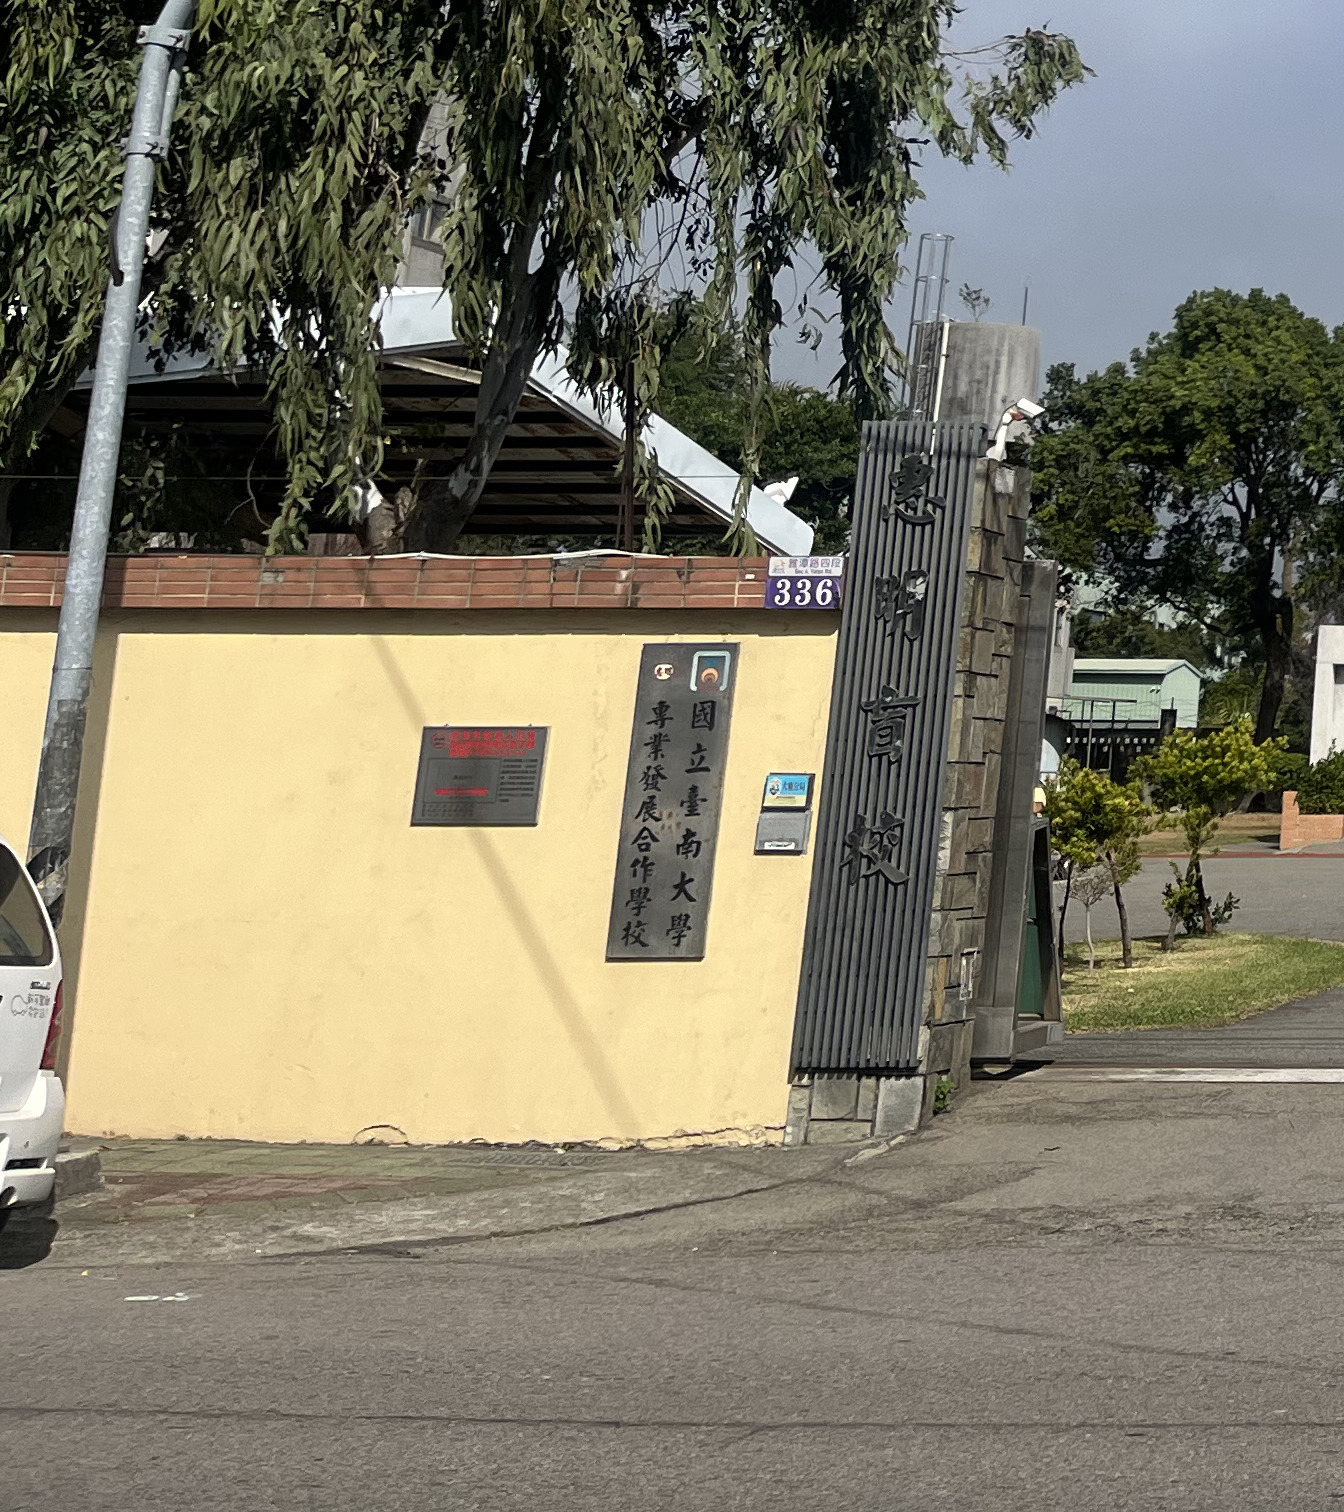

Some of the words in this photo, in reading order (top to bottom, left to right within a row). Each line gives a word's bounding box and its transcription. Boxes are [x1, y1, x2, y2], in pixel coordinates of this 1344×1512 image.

[774, 578, 833, 606] 336
[840, 454, 947, 886] 惠明盲校
[621, 699, 674, 948] 專業發展合作學校
[666, 699, 717, 948] 國立臺南大學
